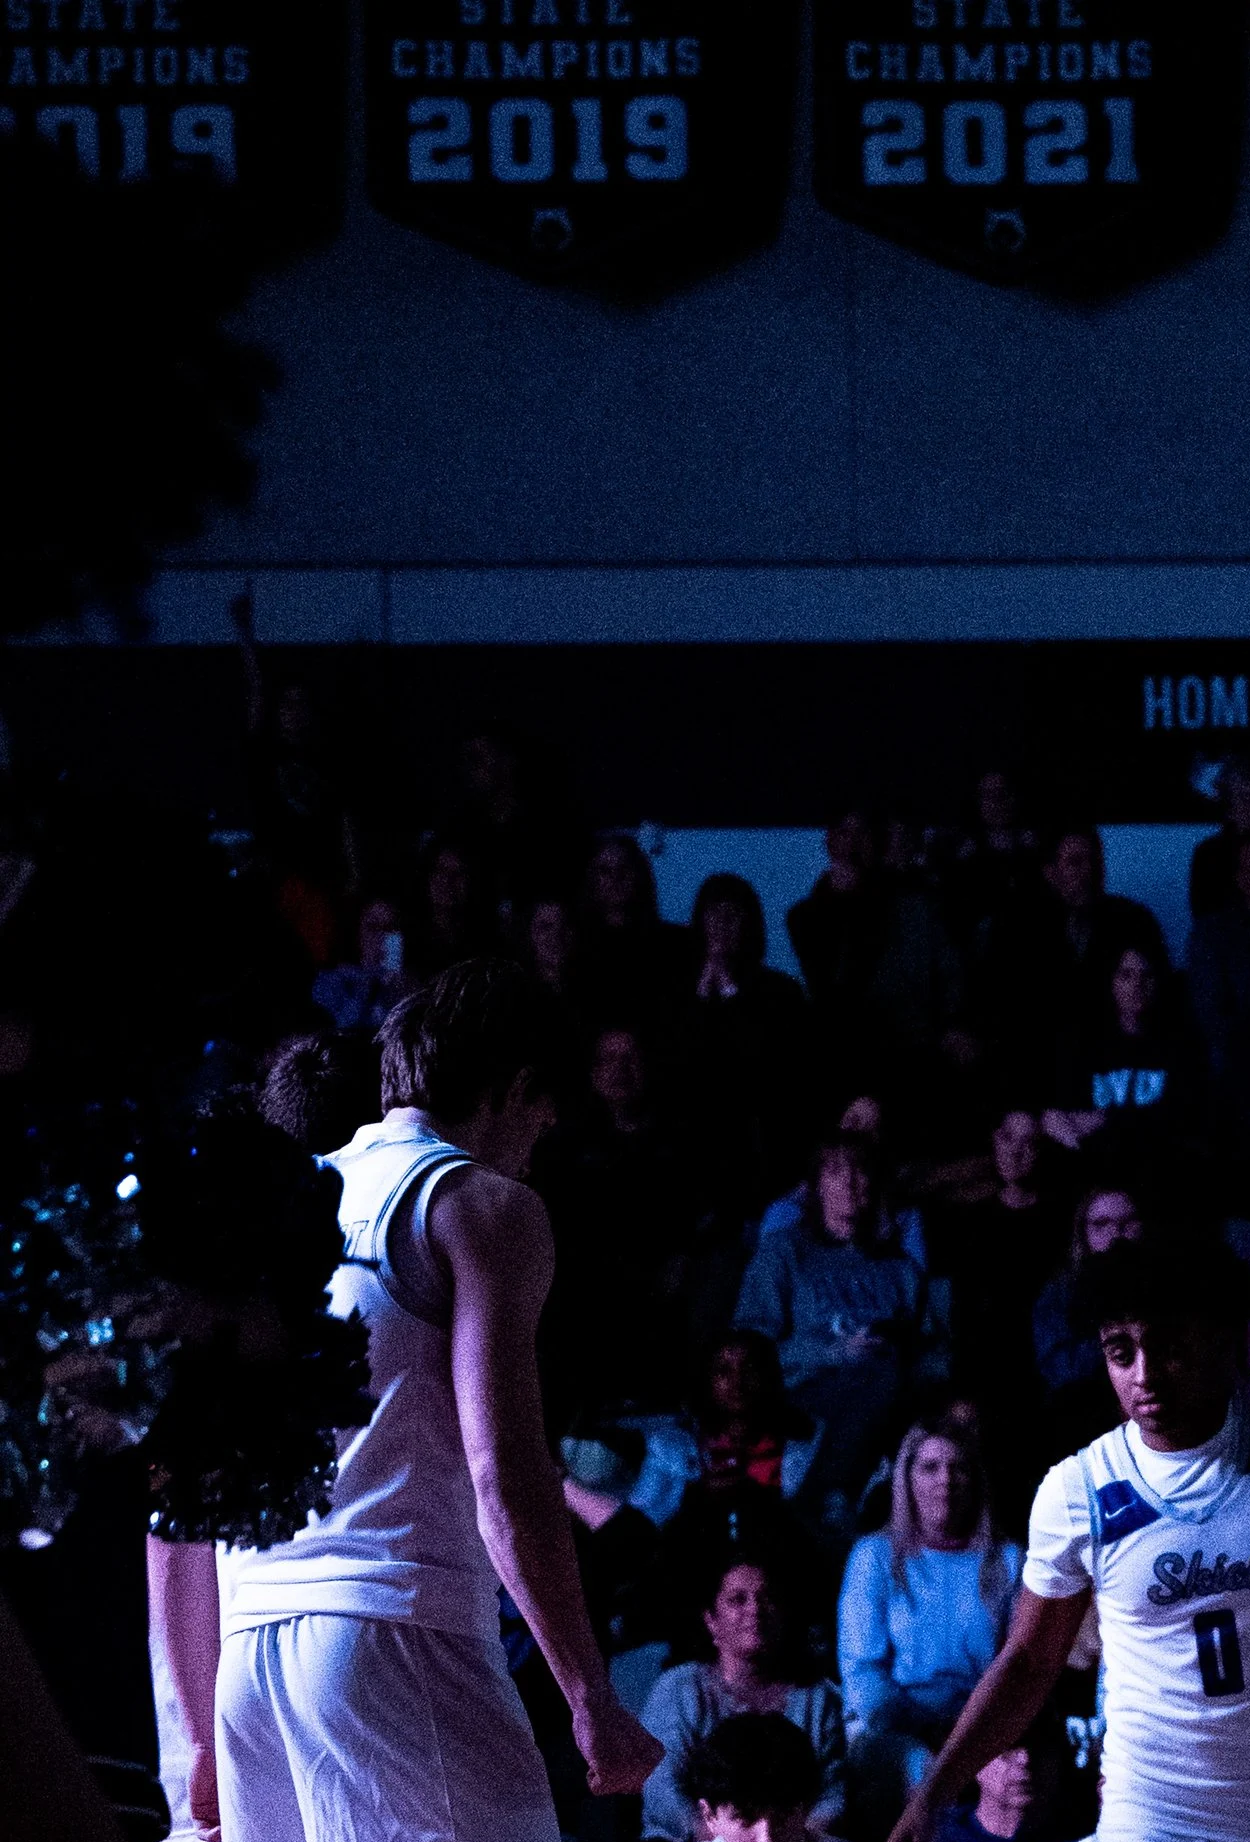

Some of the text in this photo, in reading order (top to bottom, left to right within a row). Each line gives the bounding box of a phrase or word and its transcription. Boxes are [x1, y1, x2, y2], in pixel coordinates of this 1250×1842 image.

[5, 0, 182, 32] STATE
[459, 0, 634, 26] STATE
[912, 0, 1086, 29] STATE
[0, 44, 251, 86] AMPIONS
[391, 37, 701, 80] CHAMPIONS
[845, 39, 1152, 82] CHAMPIONS
[0, 103, 240, 187] 019
[406, 94, 689, 184] 2019
[860, 97, 1140, 187] 2021
[1194, 1609, 1244, 1696] 0
